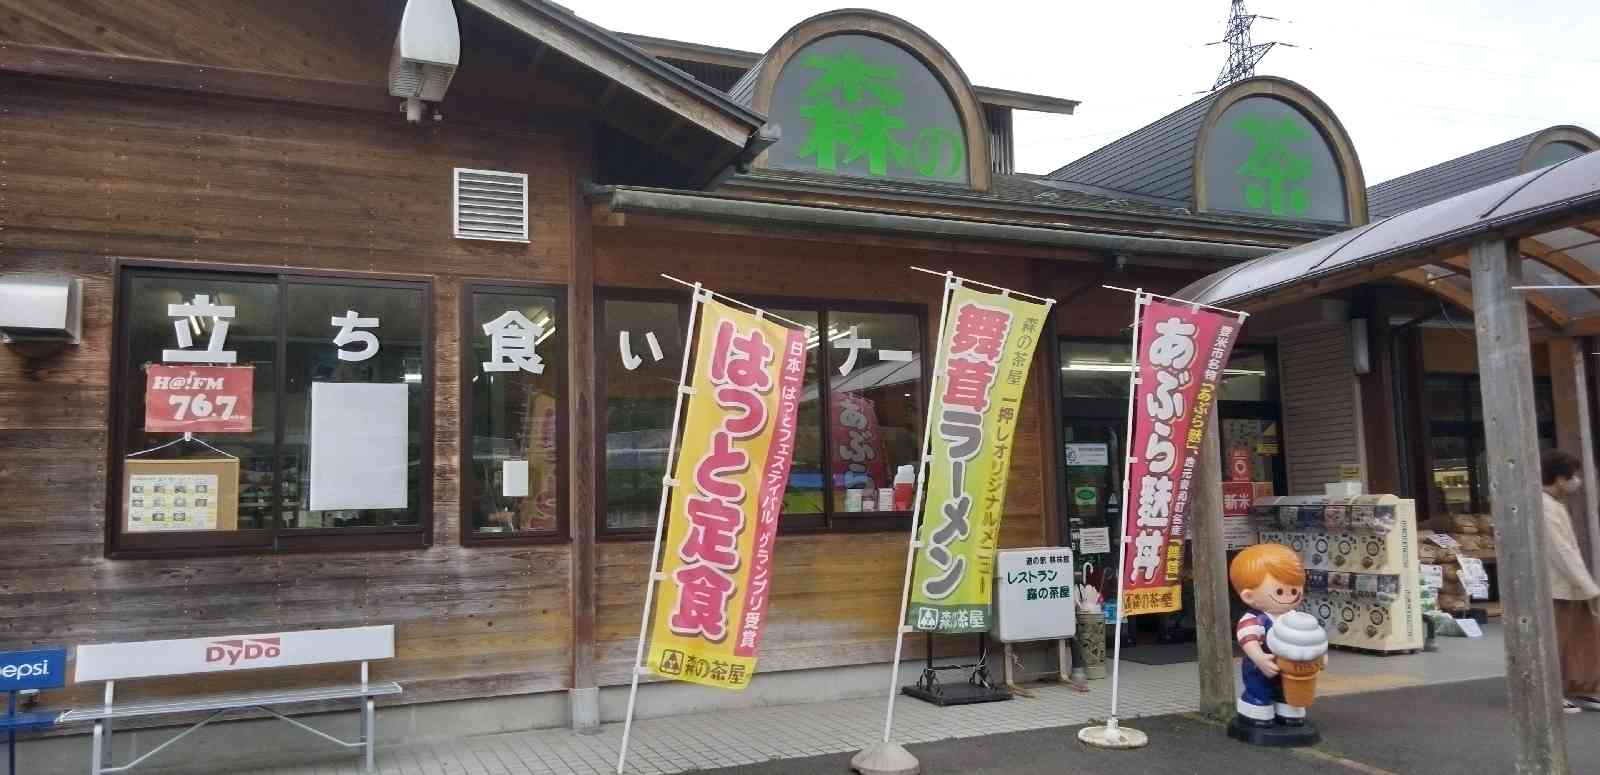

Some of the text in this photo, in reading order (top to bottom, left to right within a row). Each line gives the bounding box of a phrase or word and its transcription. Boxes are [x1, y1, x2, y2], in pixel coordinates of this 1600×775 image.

[799, 48, 964, 177] 森の
[1233, 112, 1313, 216] 茶
[168, 393, 238, 420] 76.7
[923, 300, 1014, 600] 舞茸ラーメン
[669, 319, 774, 641] はっと定食
[1223, 493, 1251, 510] 新米
[1007, 569, 1058, 585] レストラン
[1026, 585, 1071, 601] 森の茶屋
[205, 637, 281, 667] DyDo
[0, 659, 50, 681] epsi
[685, 654, 746, 685] 森の茶屋
